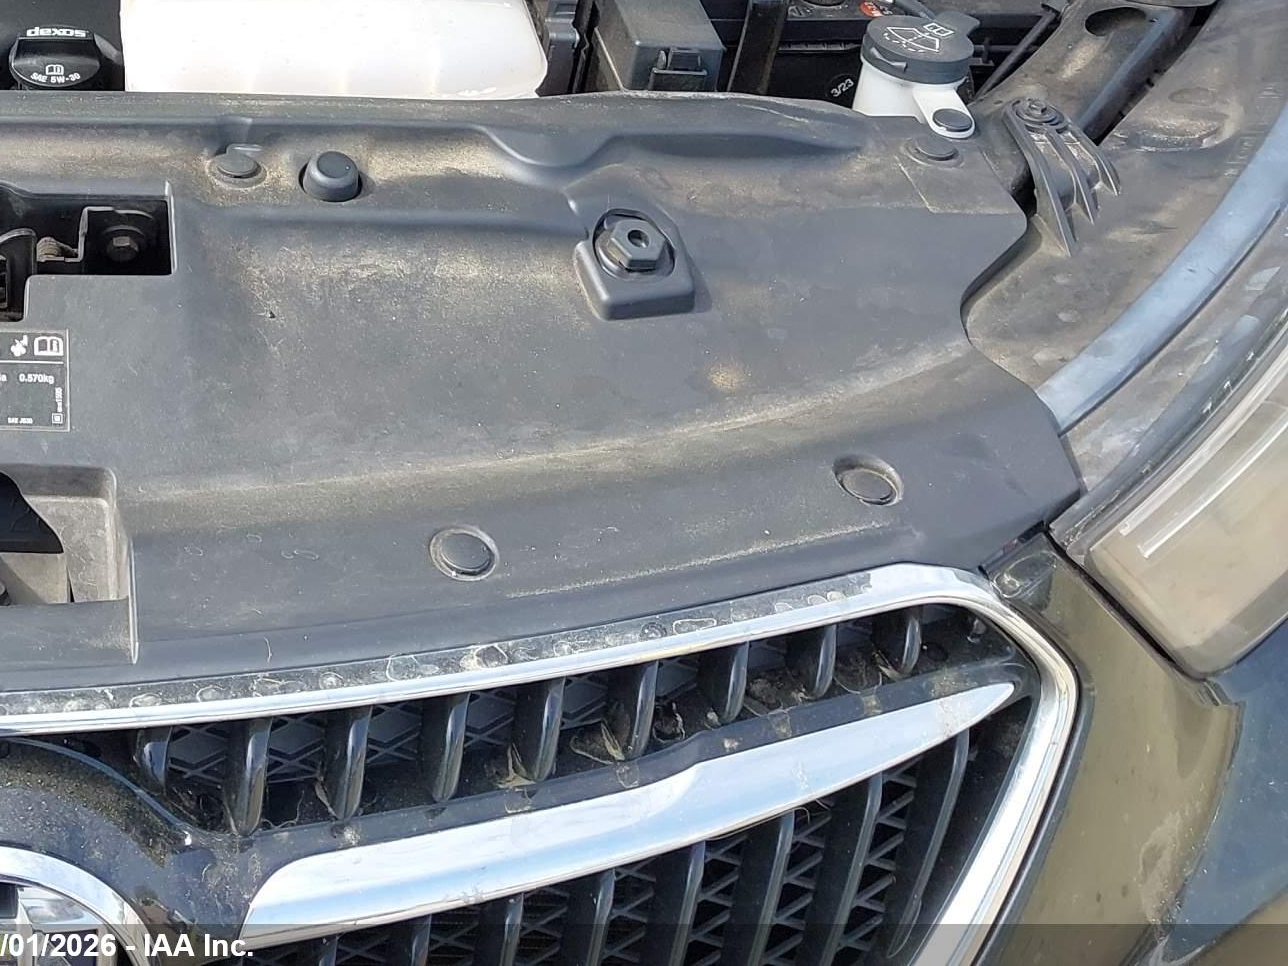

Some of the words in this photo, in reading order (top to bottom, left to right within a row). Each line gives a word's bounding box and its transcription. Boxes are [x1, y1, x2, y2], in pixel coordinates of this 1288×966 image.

[26, 26, 87, 38] dexos
[30, 72, 48, 83] SAE
[50, 72, 81, 84] 5W-30
[830, 78, 855, 98] 3/23
[18, 372, 55, 385] 0.570kg
